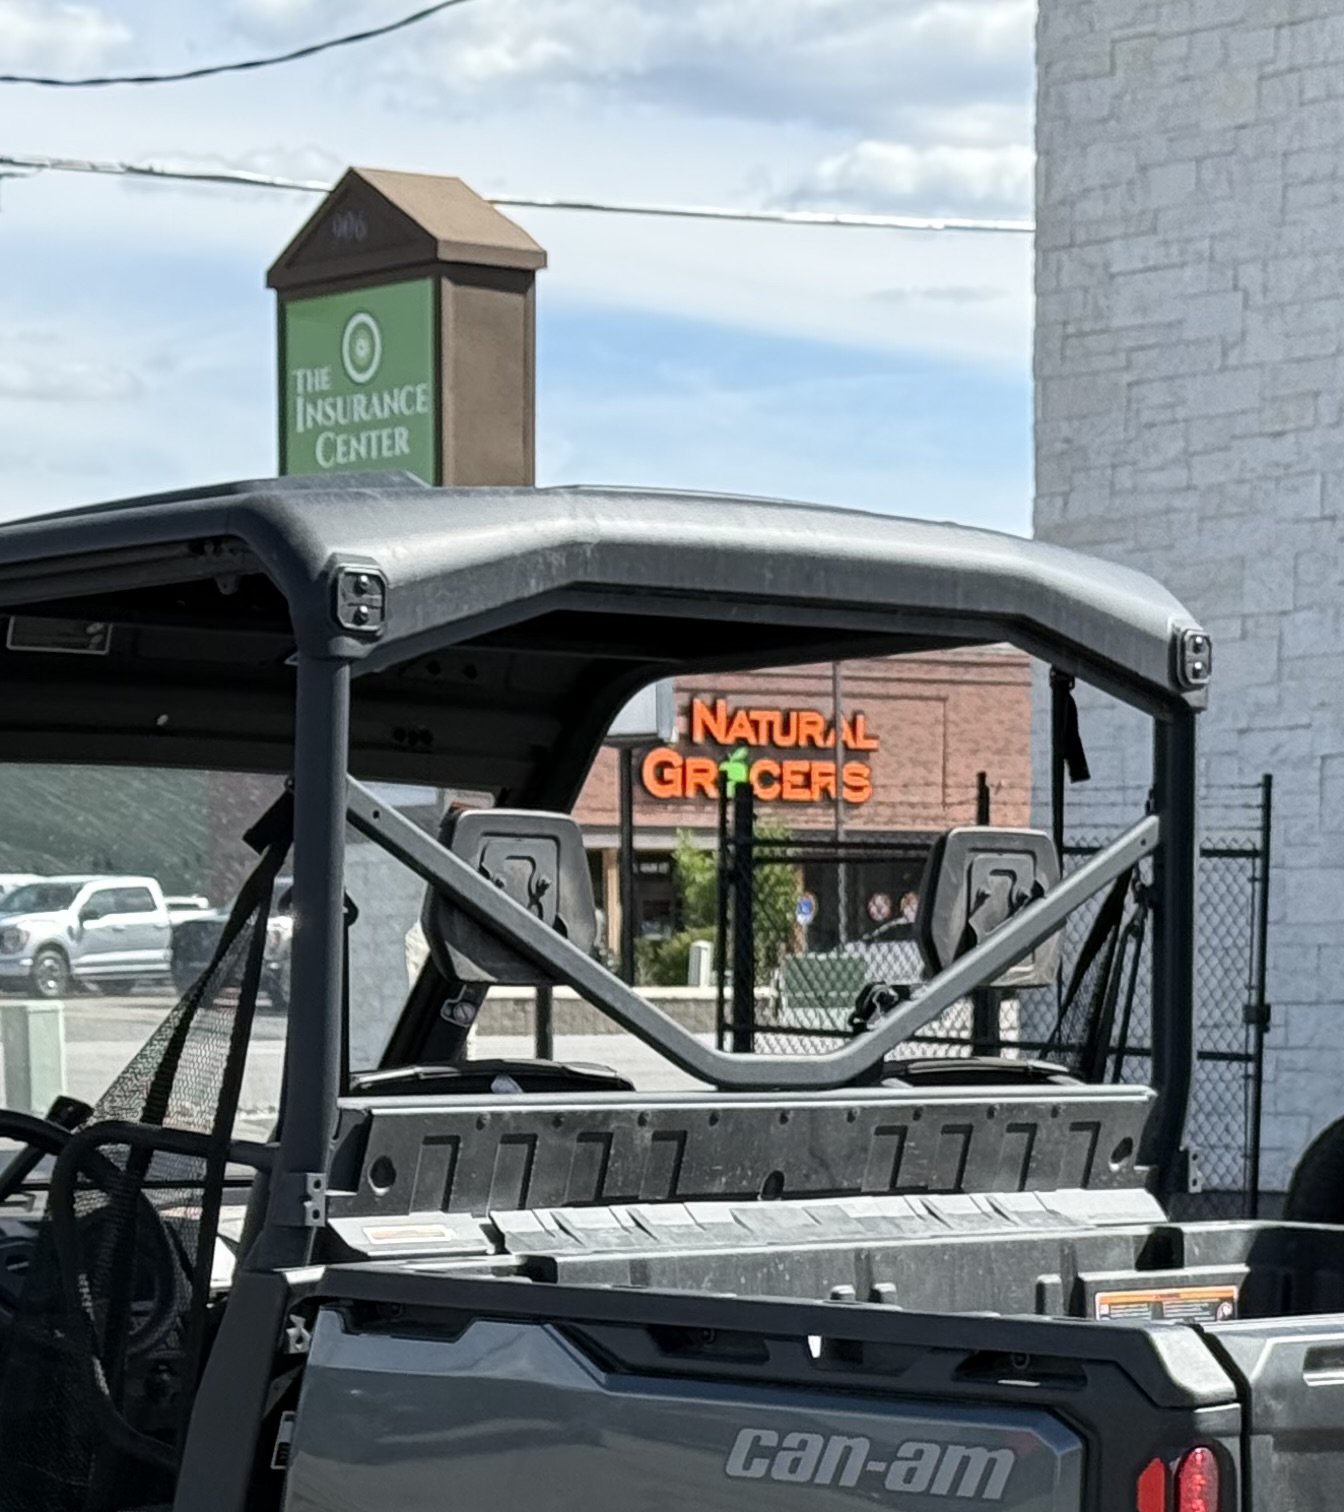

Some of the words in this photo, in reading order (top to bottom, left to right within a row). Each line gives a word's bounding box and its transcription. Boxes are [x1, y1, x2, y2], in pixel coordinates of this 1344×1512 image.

[293, 366, 331, 394] THE
[295, 383, 430, 434] INSURANCE
[315, 425, 411, 469] CENTER
[691, 698, 880, 751] NATURAL
[725, 1427, 1016, 1500] can-am
